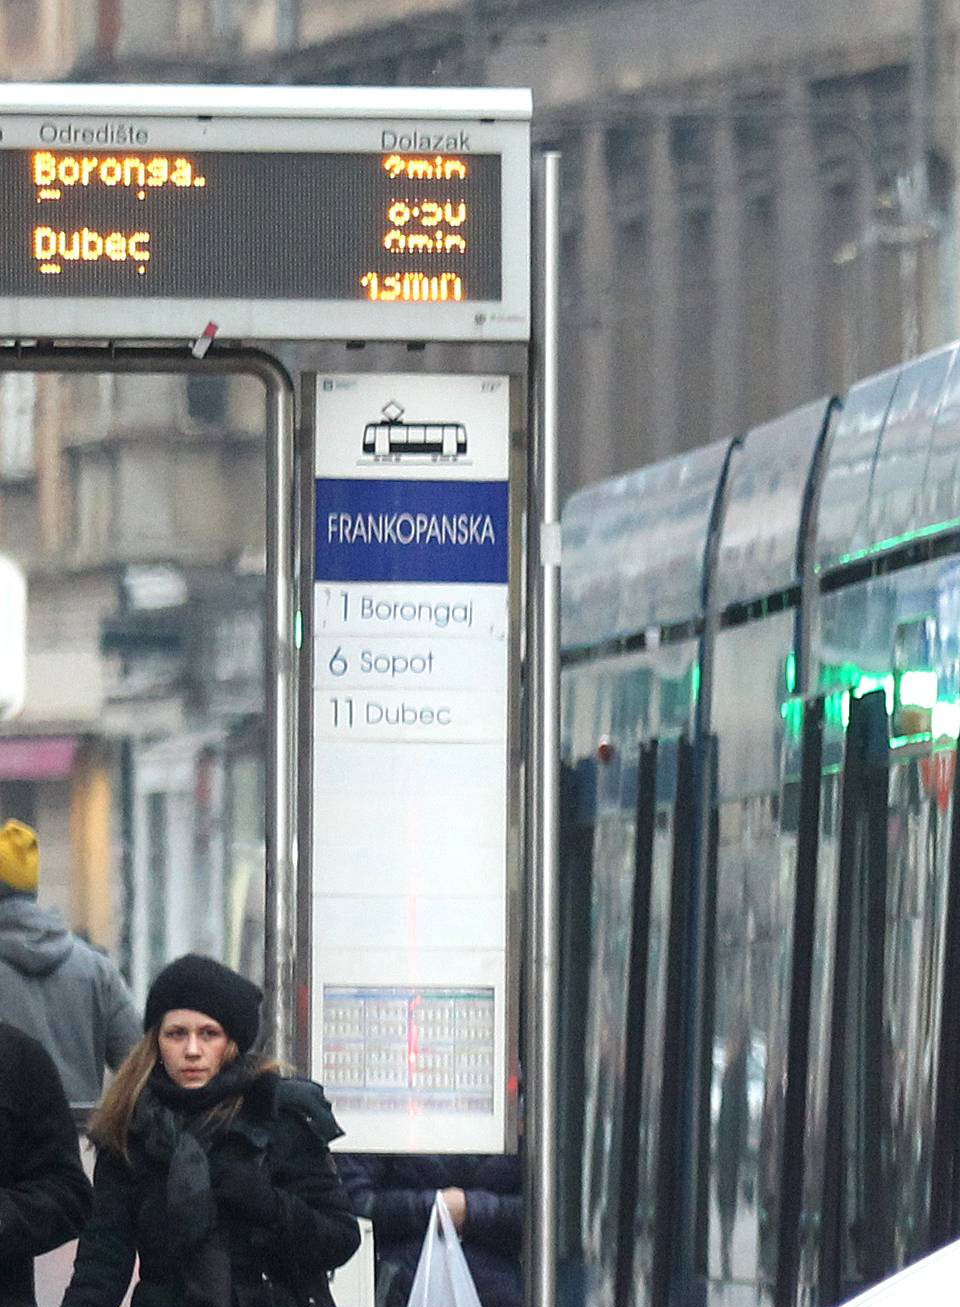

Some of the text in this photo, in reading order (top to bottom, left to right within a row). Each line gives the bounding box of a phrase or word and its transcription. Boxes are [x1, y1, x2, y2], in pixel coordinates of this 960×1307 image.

[40, 122, 149, 145] Odredište
[381, 130, 470, 151] Dolazak
[34, 226, 151, 261] Dubec
[328, 512, 496, 545] FRANKOPANSKA
[341, 591, 474, 628] 1 Borongaj
[329, 645, 434, 678] 6 Sopot
[330, 697, 452, 728] 11 Dubec
